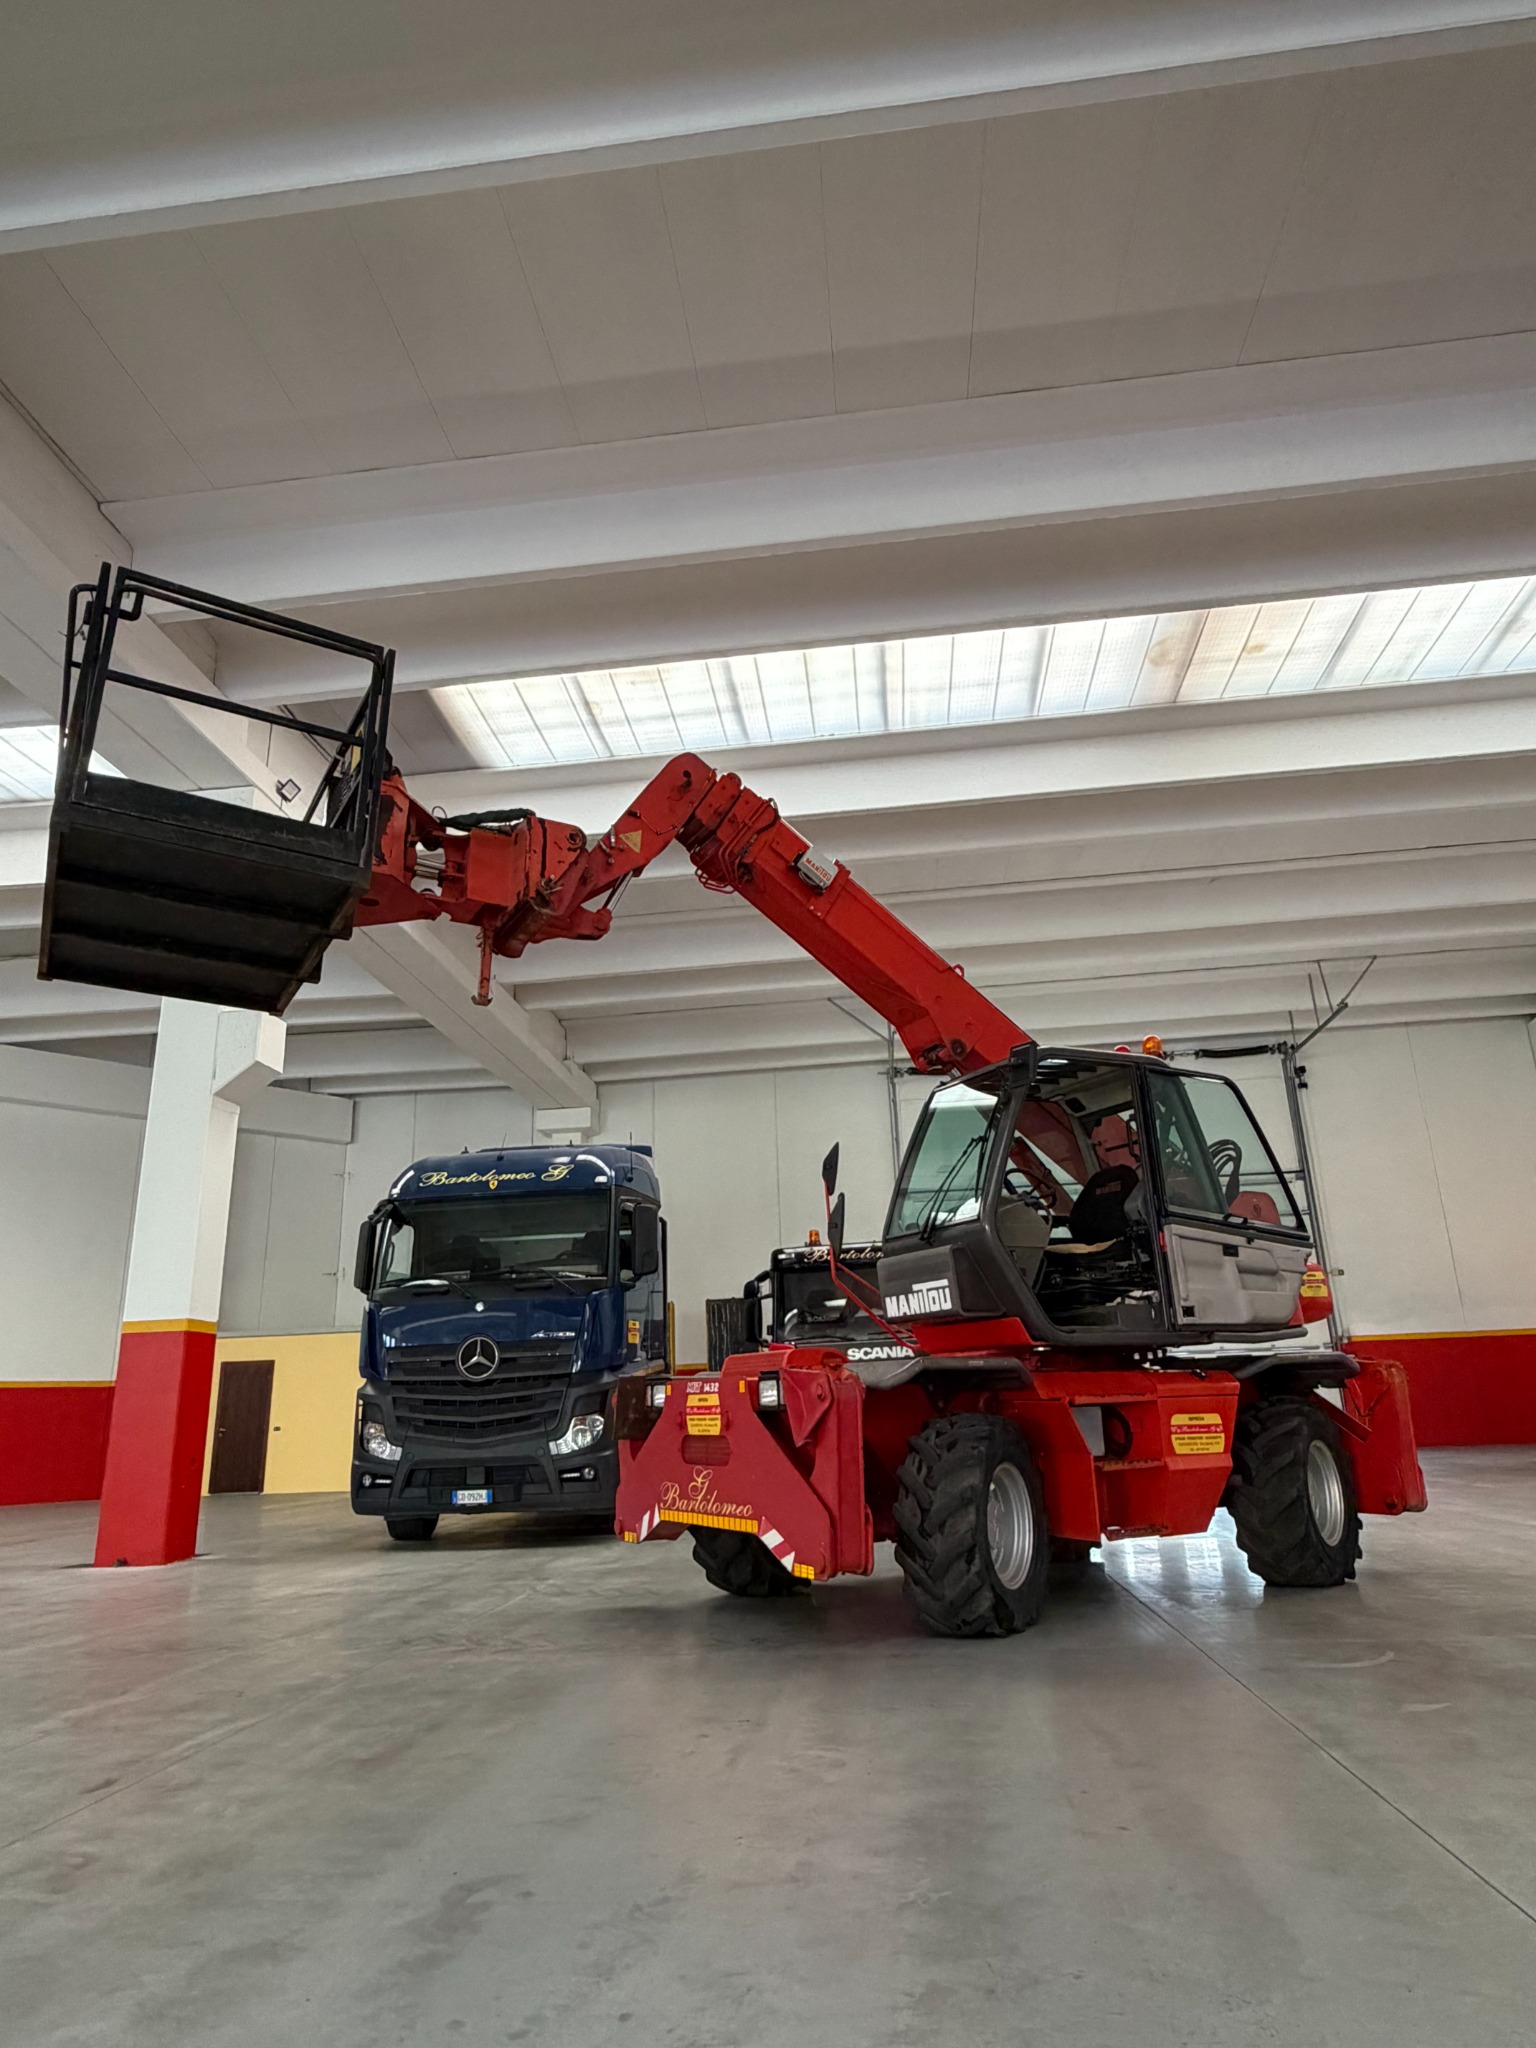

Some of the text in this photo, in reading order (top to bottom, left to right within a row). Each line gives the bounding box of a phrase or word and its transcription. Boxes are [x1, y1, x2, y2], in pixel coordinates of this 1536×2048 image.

[804, 857, 833, 882] MANITOU
[418, 1169, 536, 1188] Bartolomeo
[803, 1247, 884, 1262] Brtolo
[884, 1278, 953, 1319] MANITOU
[846, 1345, 915, 1361] SCANIA
[703, 1382, 720, 1393] 1432
[660, 1481, 753, 1517] Bartolomeo
